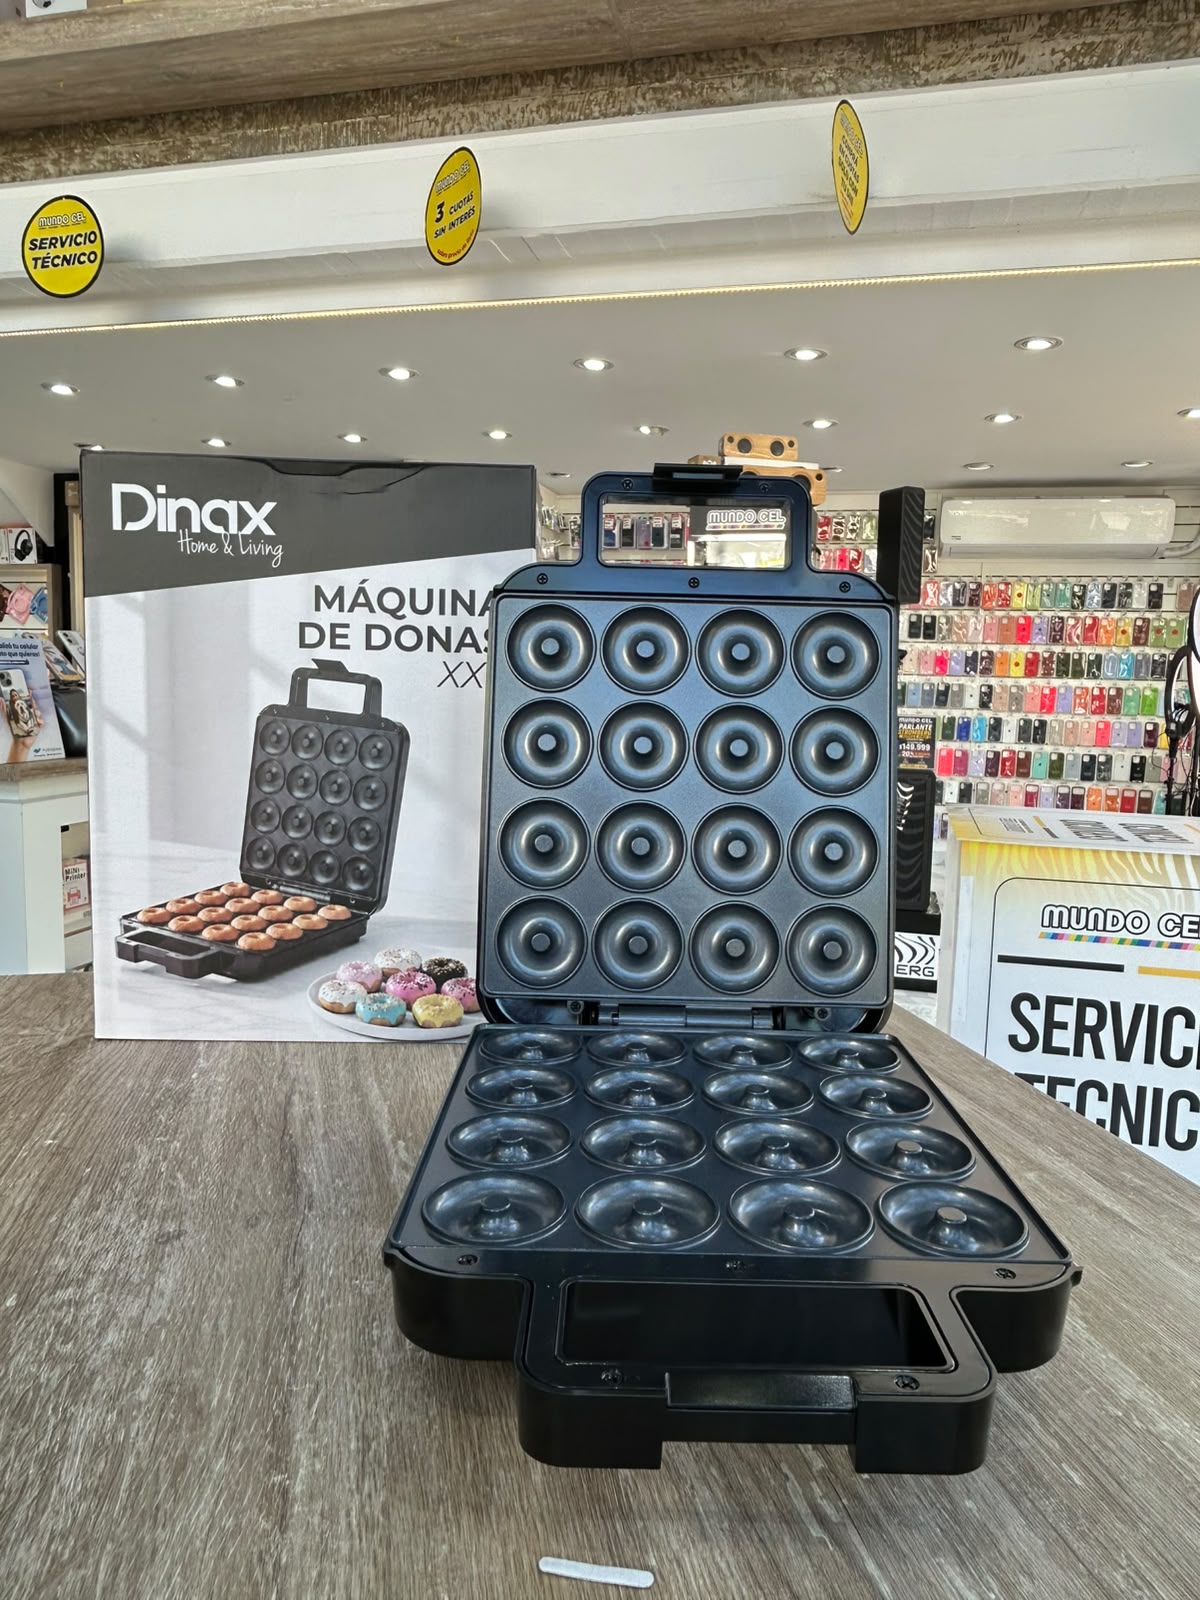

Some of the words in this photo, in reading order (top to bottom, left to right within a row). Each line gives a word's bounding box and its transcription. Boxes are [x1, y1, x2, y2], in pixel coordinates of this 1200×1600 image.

[39, 214, 69, 227] MUNDO
[71, 211, 86, 222] CEL
[435, 200, 446, 223] 3
[449, 191, 474, 215] CUOTAS
[28, 231, 97, 251] SERVICIO
[434, 225, 446, 239] SIN
[32, 251, 97, 269] TÉCNICO
[111, 483, 277, 536] Dinax
[707, 509, 757, 524] MUNDO
[757, 509, 787, 524] CEL
[178, 529, 219, 556] Home
[223, 532, 235, 556] &
[239, 532, 284, 568] Living
[299, 621, 350, 651] DE
[364, 624, 489, 655] DONA
[437, 660, 487, 688] XX
[899, 722, 933, 731] PARLANTE
[1041, 904, 1151, 935] MUNDO
[1157, 912, 1200, 940] CE
[896, 964, 935, 977] ERG
[1008, 992, 1200, 1071] SERVIC
[1014, 1072, 1200, 1152] CNIC
